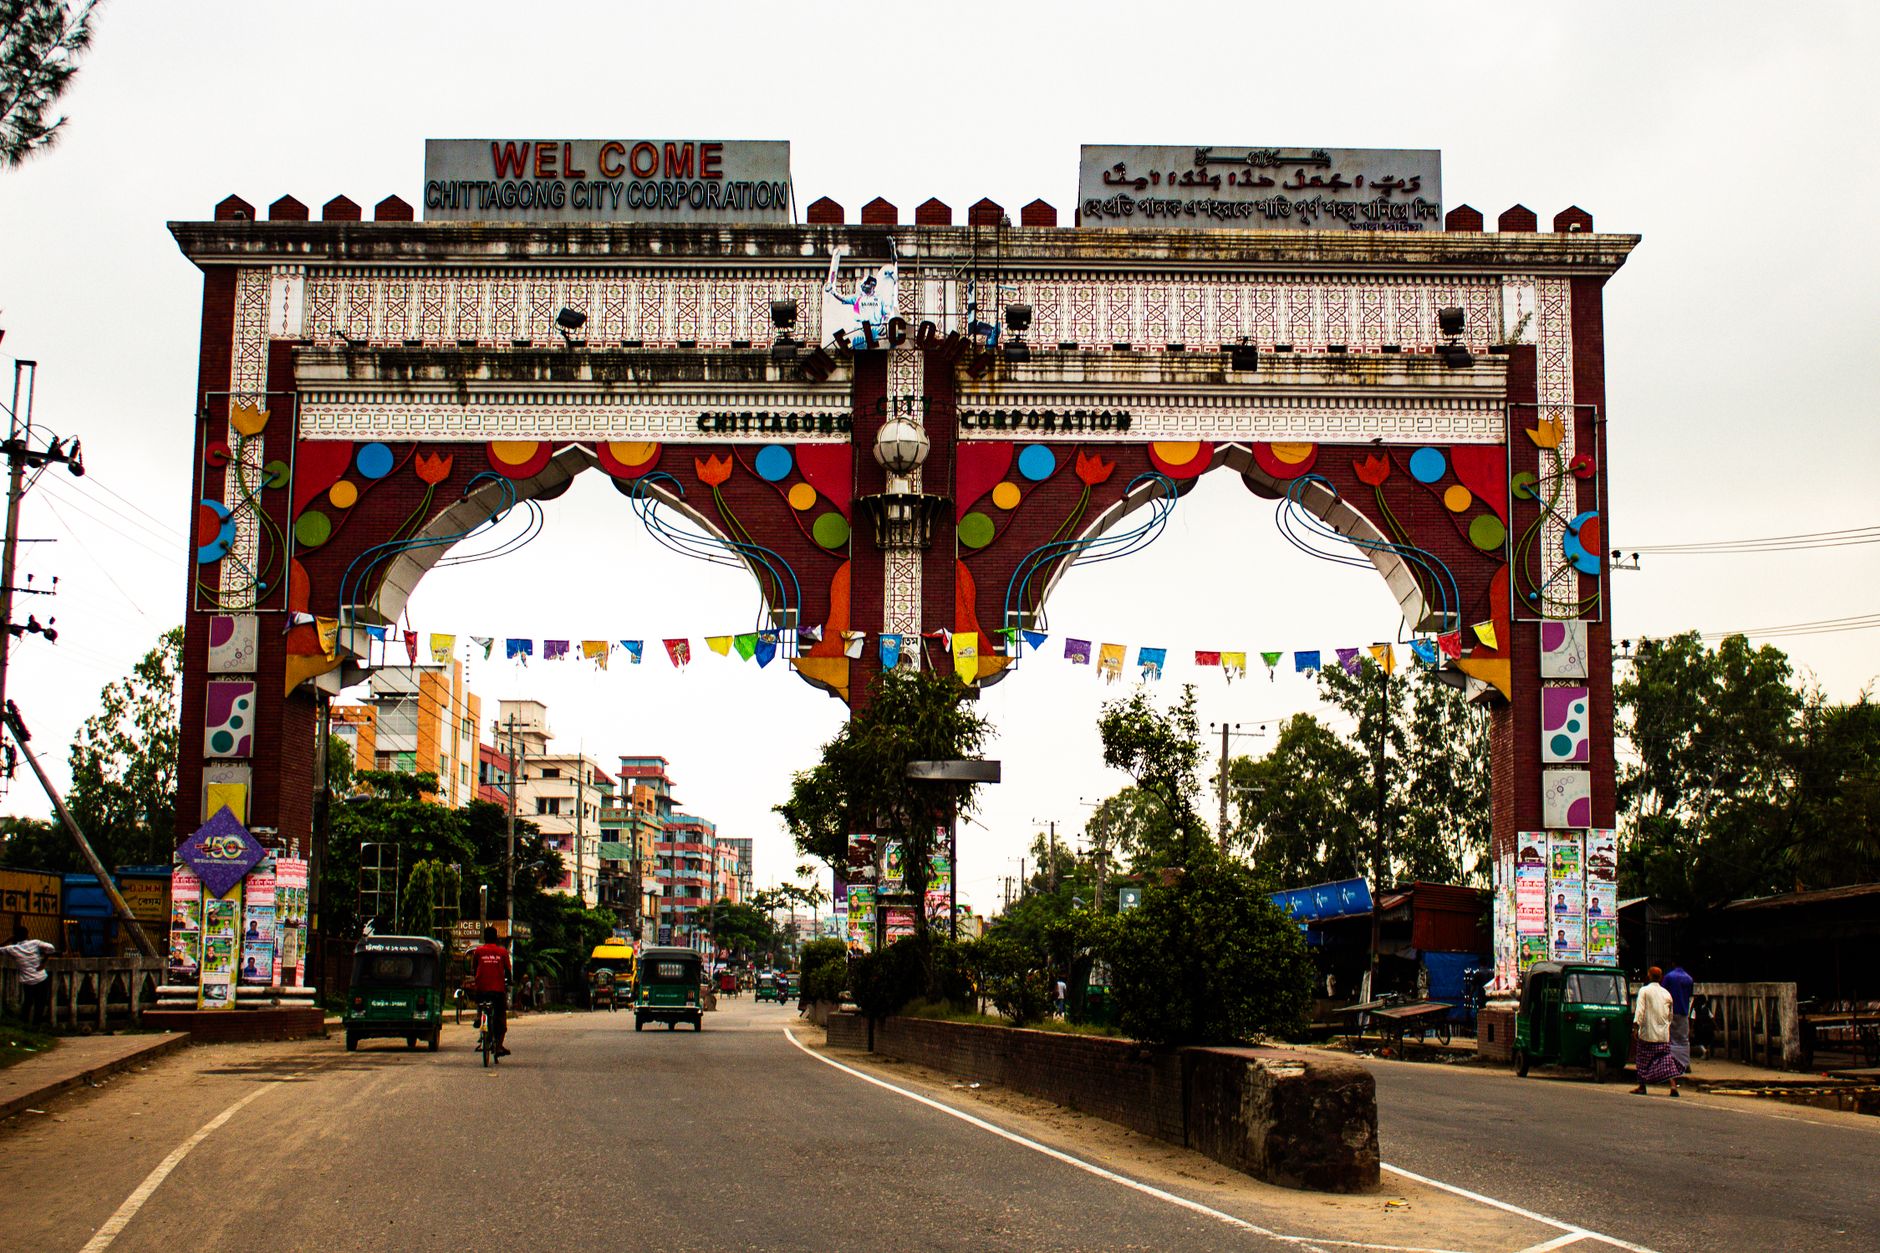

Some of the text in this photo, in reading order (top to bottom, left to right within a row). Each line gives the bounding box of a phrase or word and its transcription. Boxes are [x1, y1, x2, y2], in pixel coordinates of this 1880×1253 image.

[491, 141, 724, 179] WELCOME
[426, 180, 787, 210] CHITTAGONG CITY CORPORATION
[697, 411, 850, 433] CHITTAGONG
[961, 409, 1133, 432] CORPORATION
